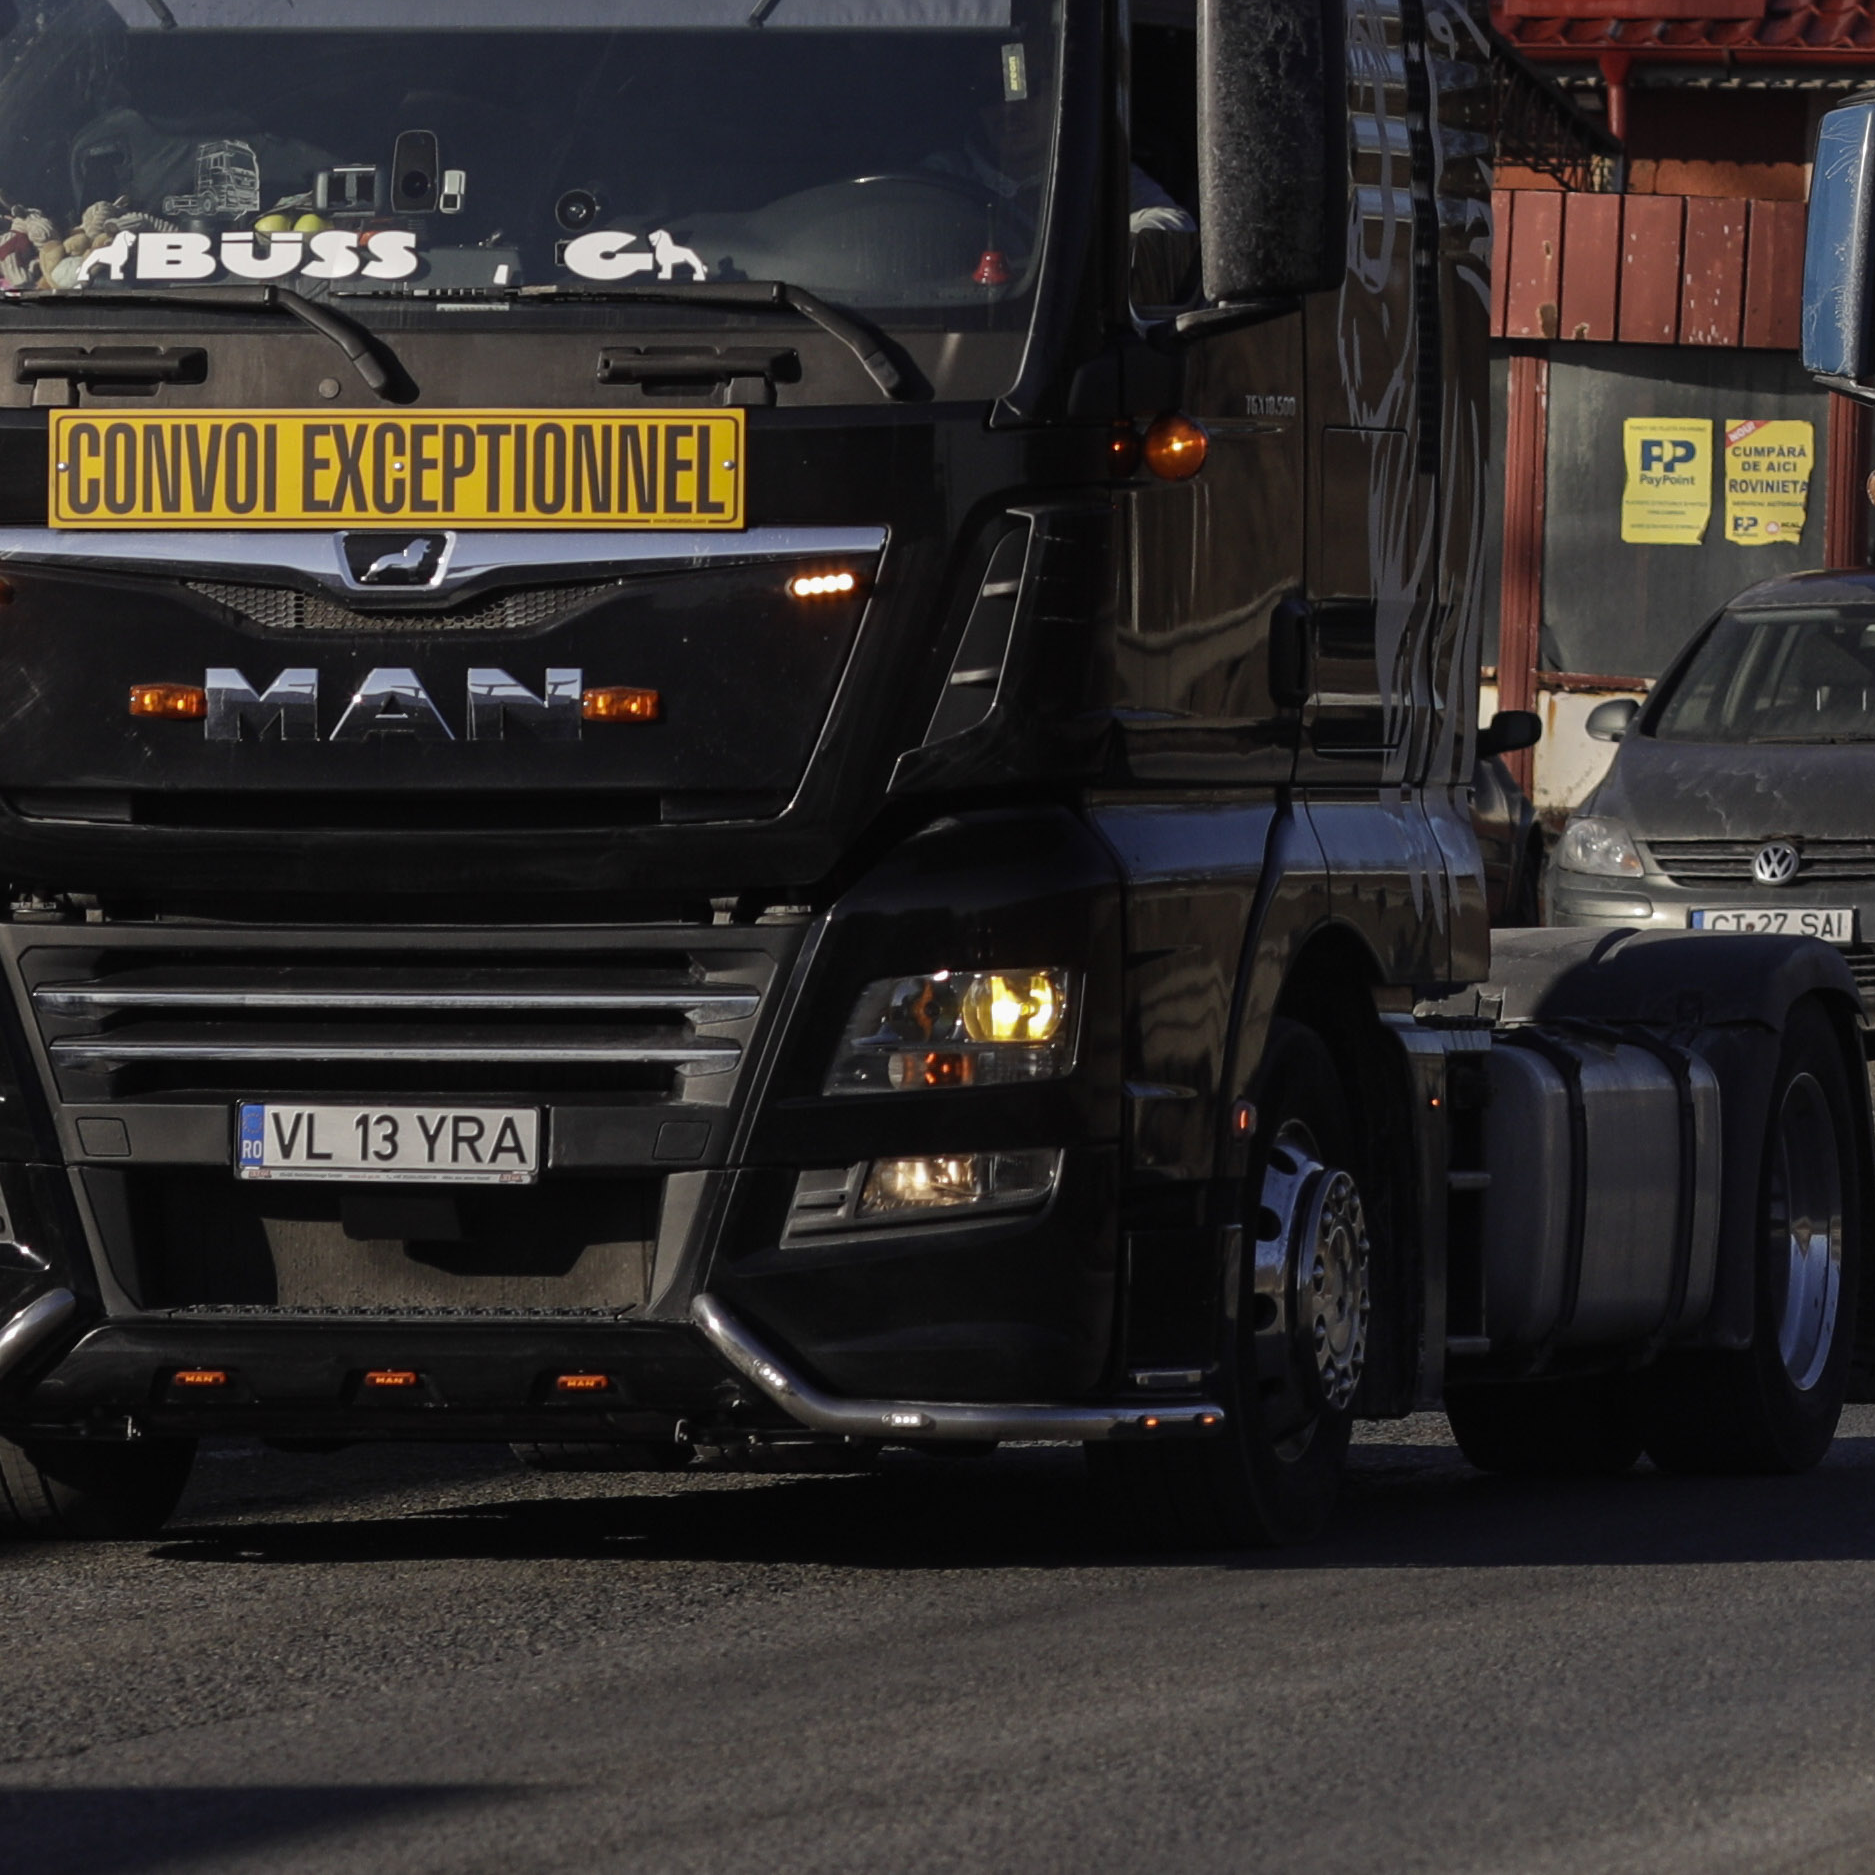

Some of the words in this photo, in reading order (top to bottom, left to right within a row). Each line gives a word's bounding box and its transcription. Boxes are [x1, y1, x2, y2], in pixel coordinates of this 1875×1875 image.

[67, 422, 277, 514] CONVOI
[302, 424, 725, 514] EXCEPTIONNEL
[1741, 461, 1761, 473] DE
[1766, 461, 1798, 473] AICI
[1639, 474, 1696, 488] PayPoint
[204, 667, 583, 741] MAN
[1757, 913, 1789, 934] 27
[1800, 913, 1842, 938] SAI
[242, 1139, 263, 1159] RO
[271, 1112, 333, 1160] VL
[354, 1112, 399, 1162] 13
[416, 1113, 527, 1164] YRA
